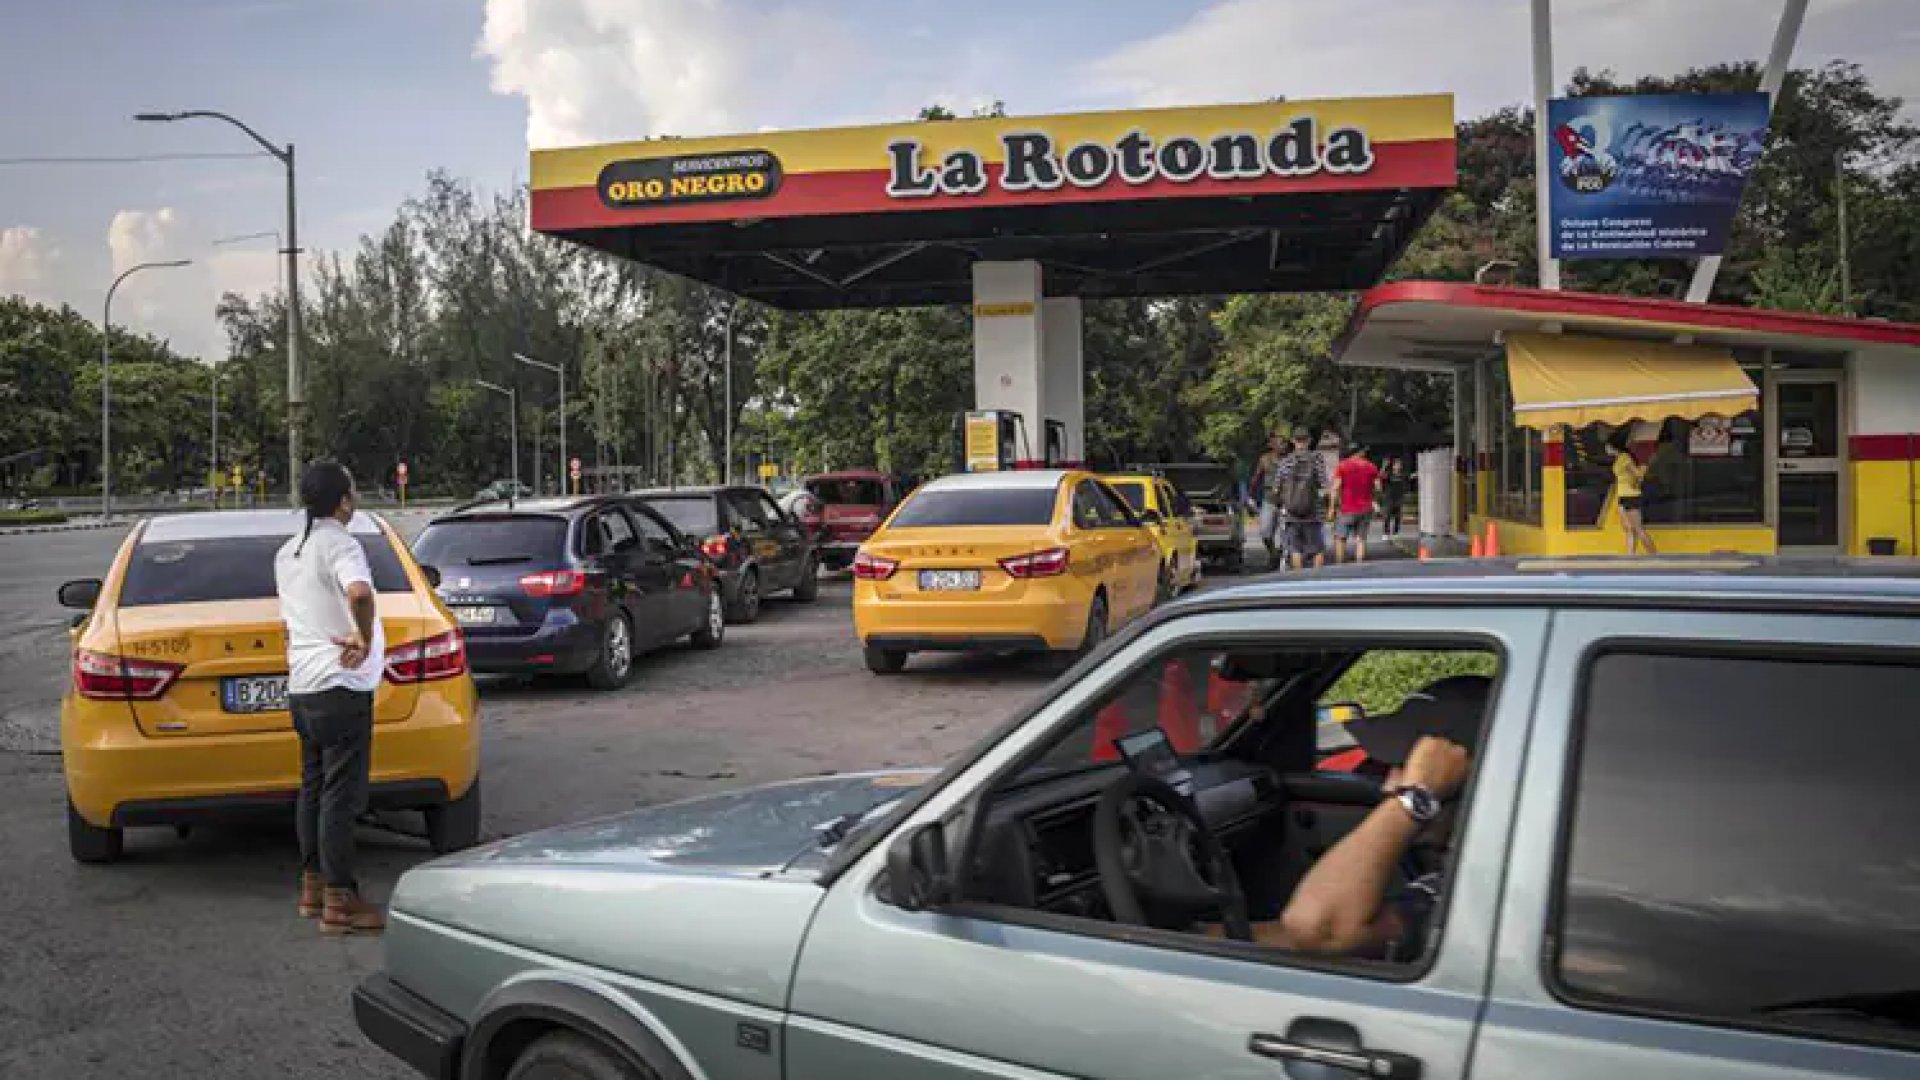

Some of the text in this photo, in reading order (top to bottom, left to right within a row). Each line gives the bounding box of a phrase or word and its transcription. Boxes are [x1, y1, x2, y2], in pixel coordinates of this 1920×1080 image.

[886, 115, 1375, 196] La Rotonda
[608, 172, 764, 200] ORO NEGRO
